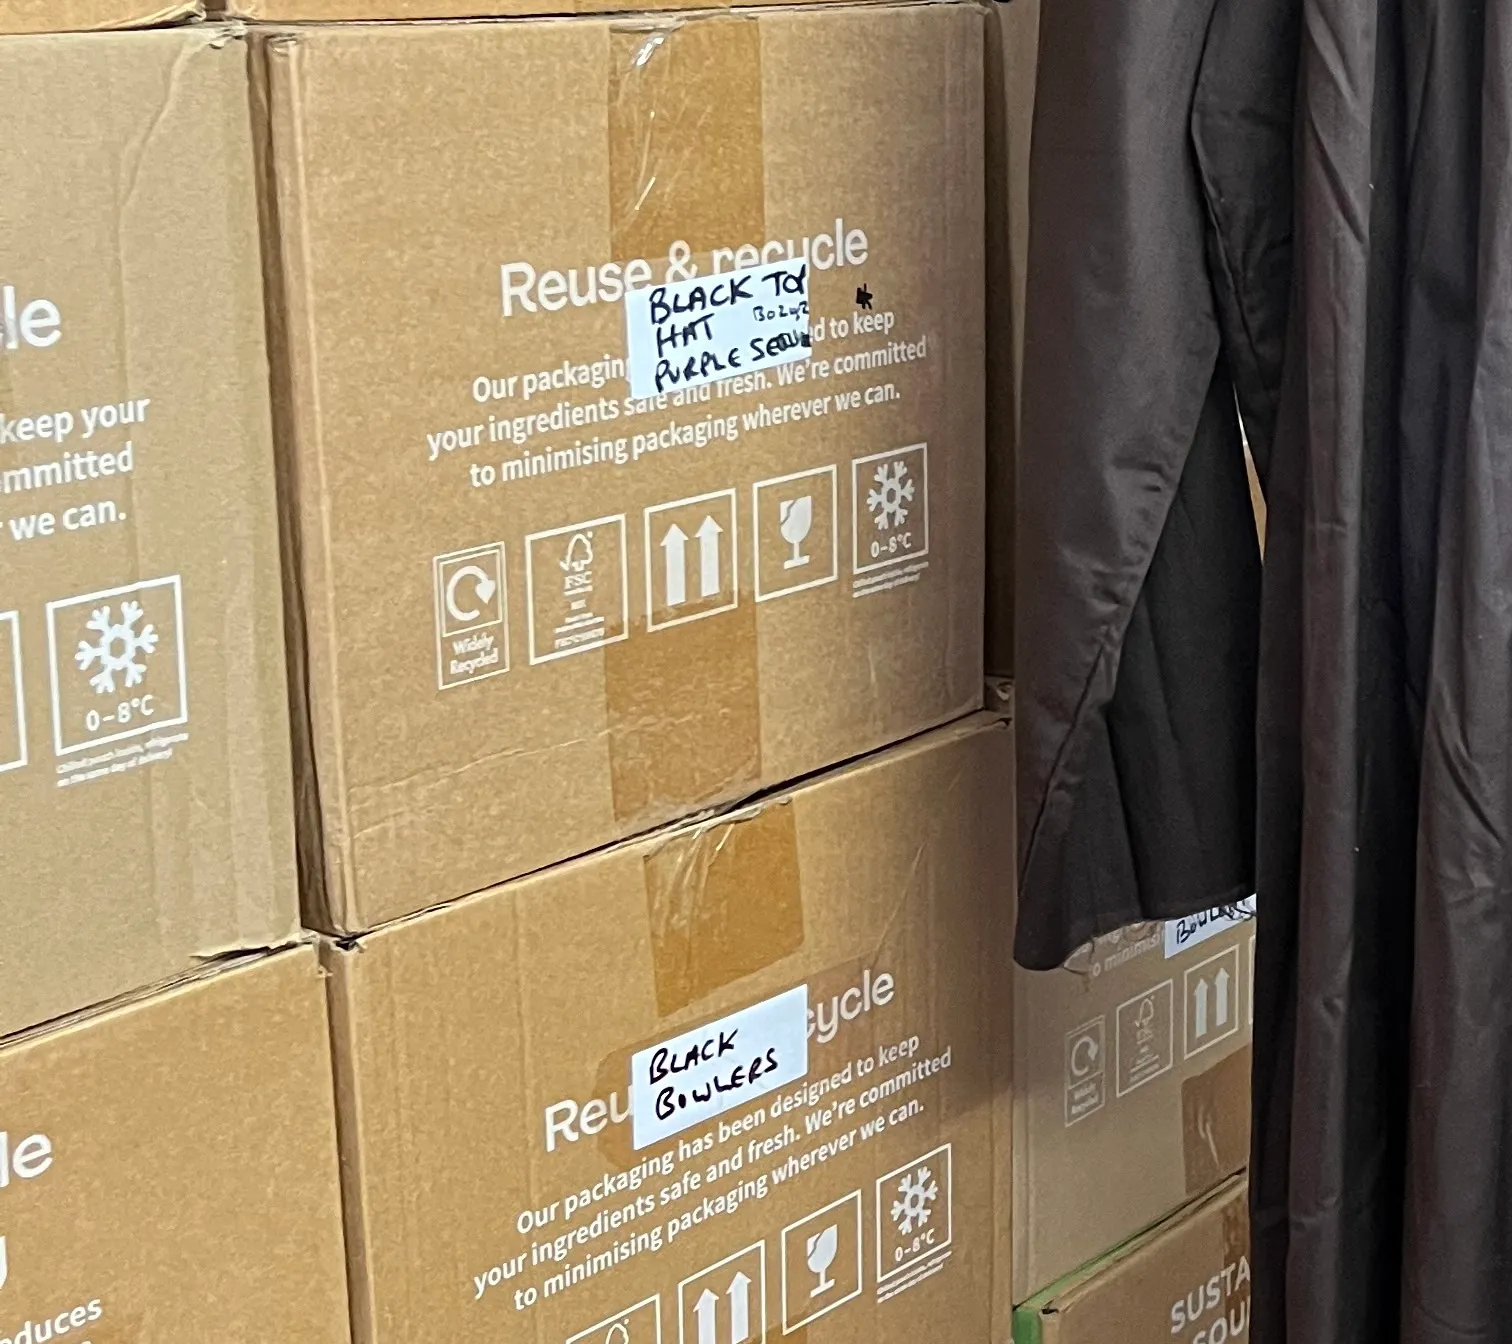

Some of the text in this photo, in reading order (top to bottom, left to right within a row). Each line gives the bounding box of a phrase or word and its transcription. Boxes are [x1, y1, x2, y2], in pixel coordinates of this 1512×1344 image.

[501, 257, 653, 317] Reuse
[665, 239, 698, 283] &
[649, 275, 753, 325] BLACK
[472, 375, 518, 402] Our
[830, 320, 849, 338] to
[853, 311, 895, 335] keep
[655, 348, 741, 393] PURPLE
[656, 313, 715, 358] HAT
[80, 398, 150, 439] your
[426, 423, 484, 462] your
[489, 397, 620, 444] ingredients
[833, 335, 927, 374] committed
[470, 382, 901, 487] to minimising packaging wherever we can.
[9, 499, 127, 541] we can.
[807, 969, 895, 1044] ycle
[650, 1028, 738, 1086] BLACK
[655, 1047, 778, 1120] BOWLERS
[516, 1035, 919, 1234] Our packaging has been designed to keep
[474, 1256, 527, 1300] your
[532, 1192, 656, 1264] ingredients
[660, 1172, 701, 1212] safe
[706, 1155, 743, 1185] and
[748, 1123, 800, 1165] fresh.
[859, 1046, 952, 1110] committed
[514, 1098, 924, 1311] to minimising packaging wherever we can.
